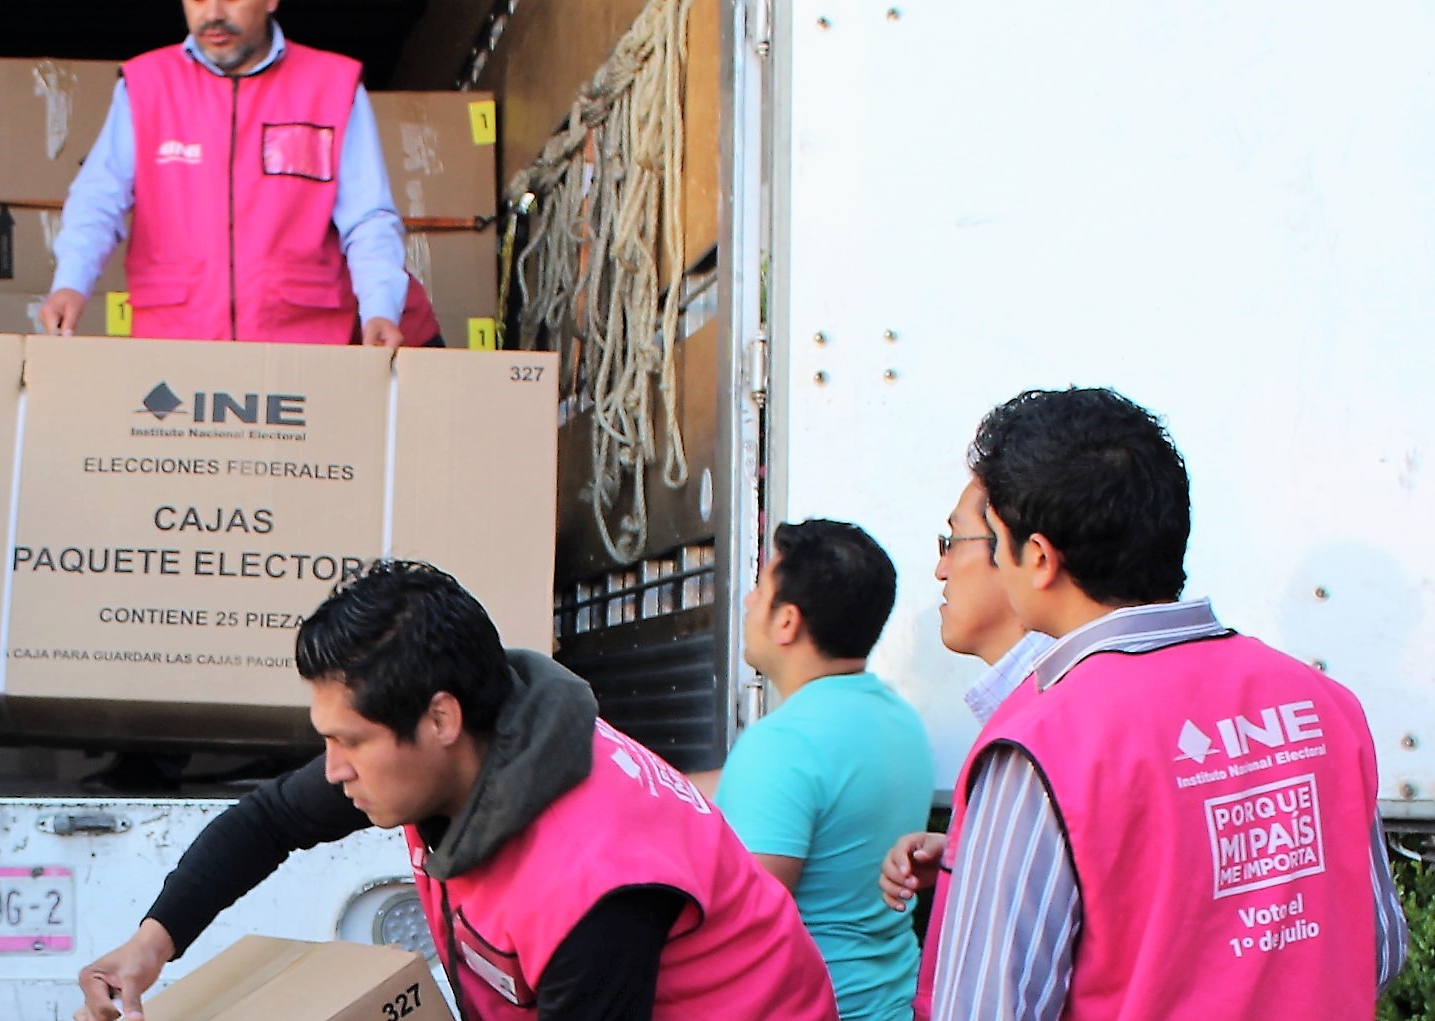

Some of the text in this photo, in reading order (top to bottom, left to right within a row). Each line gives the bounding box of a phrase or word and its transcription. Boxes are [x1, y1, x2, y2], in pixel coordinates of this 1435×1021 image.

[479, 113, 489, 130] 1
[117, 303, 126, 321] 1
[477, 329, 486, 347] 1
[509, 365, 545, 382] 327
[192, 390, 307, 427] INE
[188, 428, 245, 440] Nacional
[248, 430, 307, 442] Electoral
[83, 456, 355, 481] ELECCIONES FEDERALES
[154, 506, 274, 534] CAJAS
[13, 546, 365, 583] PAQUETE ELECTOR
[99, 607, 305, 629] CONTIENE 25 PIEZA
[13, 648, 49, 660] CAJA
[53, 649, 90, 661] PARA
[94, 650, 162, 664] GUARDAR
[166, 653, 192, 664] LAS
[196, 654, 243, 666] CAJAS
[247, 655, 296, 669] PAQUE
[1216, 699, 1324, 760] INE
[1176, 769, 1227, 788] Instituto
[1214, 786, 1312, 832] PORQUE
[1219, 811, 1316, 867] MI PAÍS
[1219, 846, 1317, 886] ME IMPORTA
[1288, 892, 1304, 916] el
[1278, 919, 1320, 951] julio
